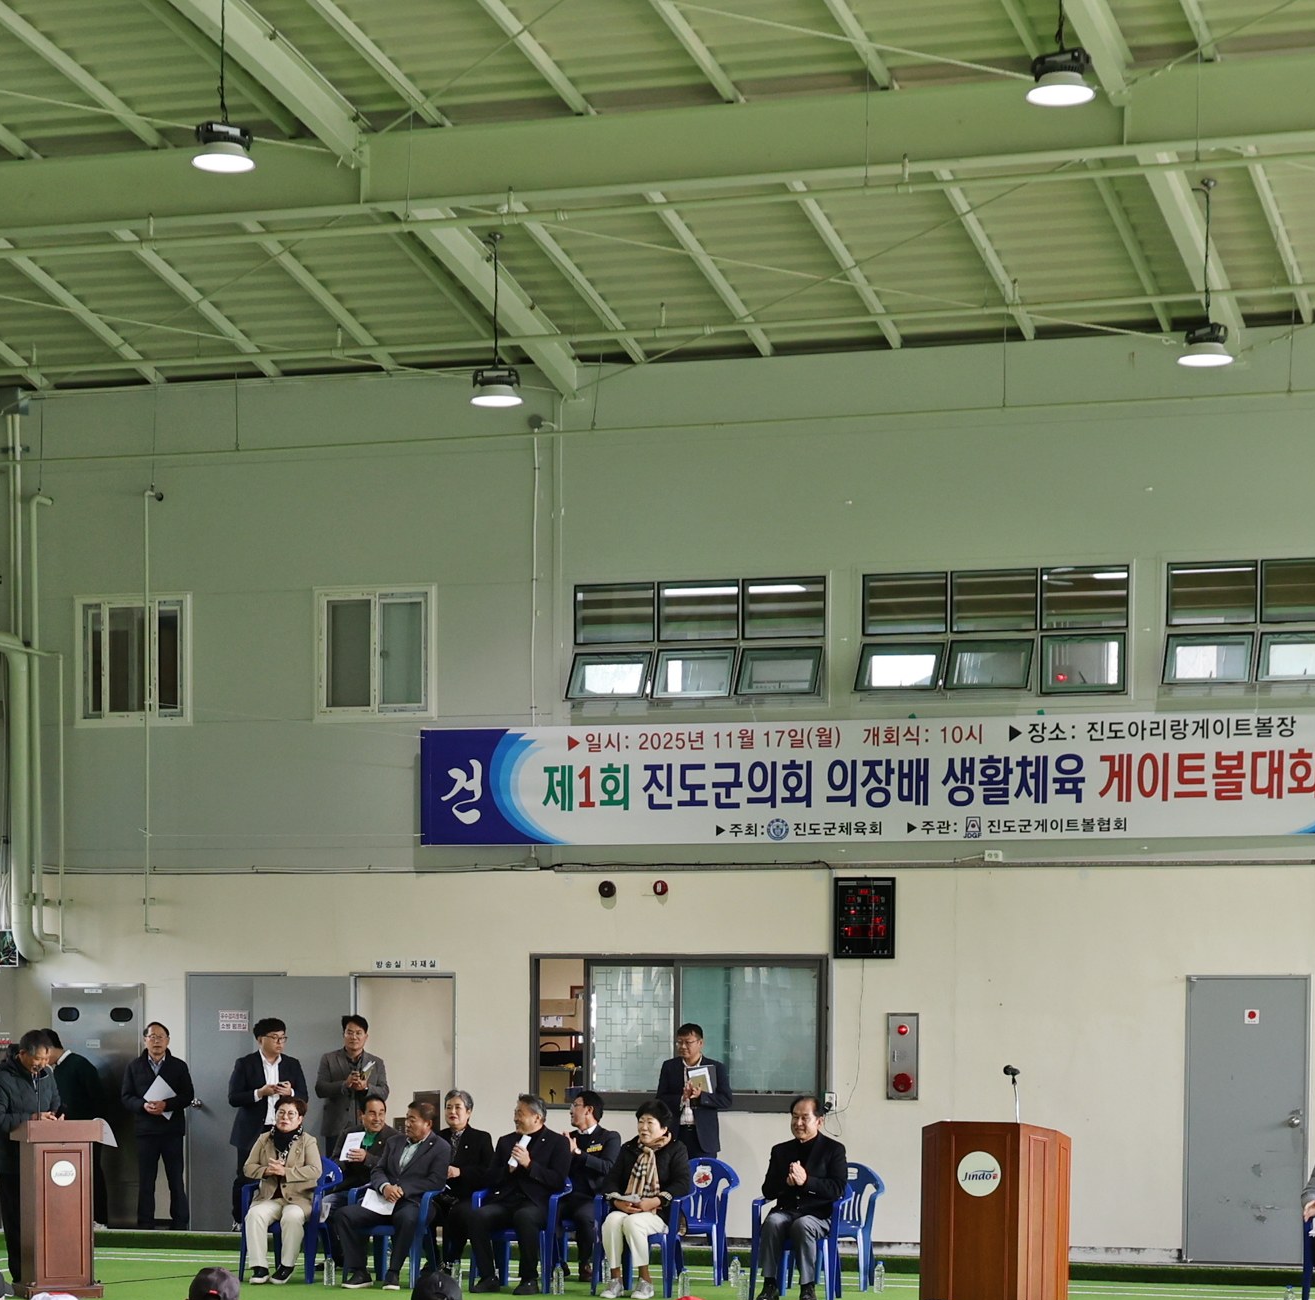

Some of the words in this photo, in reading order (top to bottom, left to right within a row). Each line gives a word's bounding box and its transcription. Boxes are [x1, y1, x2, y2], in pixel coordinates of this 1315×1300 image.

[585, 732, 630, 753] 일시:
[638, 730, 705, 752] 2025년
[713, 729, 755, 751] 11월
[762, 726, 841, 750] 17일(월)
[862, 726, 930, 748] 개회식:
[940, 721, 983, 745] 10시
[1027, 721, 1077, 742] 장소:
[1086, 715, 1296, 743] 진도아리랑게이트볼장
[440, 758, 483, 825] 건
[542, 763, 630, 812] 제1회
[642, 759, 812, 810] 진도군의회
[826, 758, 930, 809] 의장배
[941, 753, 1086, 806] 생활체육
[729, 822, 765, 838] 주최:
[793, 819, 883, 838] 진도군체육회
[920, 819, 959, 836] 주관:
[986, 815, 1128, 834] 진도군게이트볼협회
[375, 959, 402, 969] 방송실
[410, 959, 437, 969] 자재실
[961, 1169, 993, 1183] Jindo
